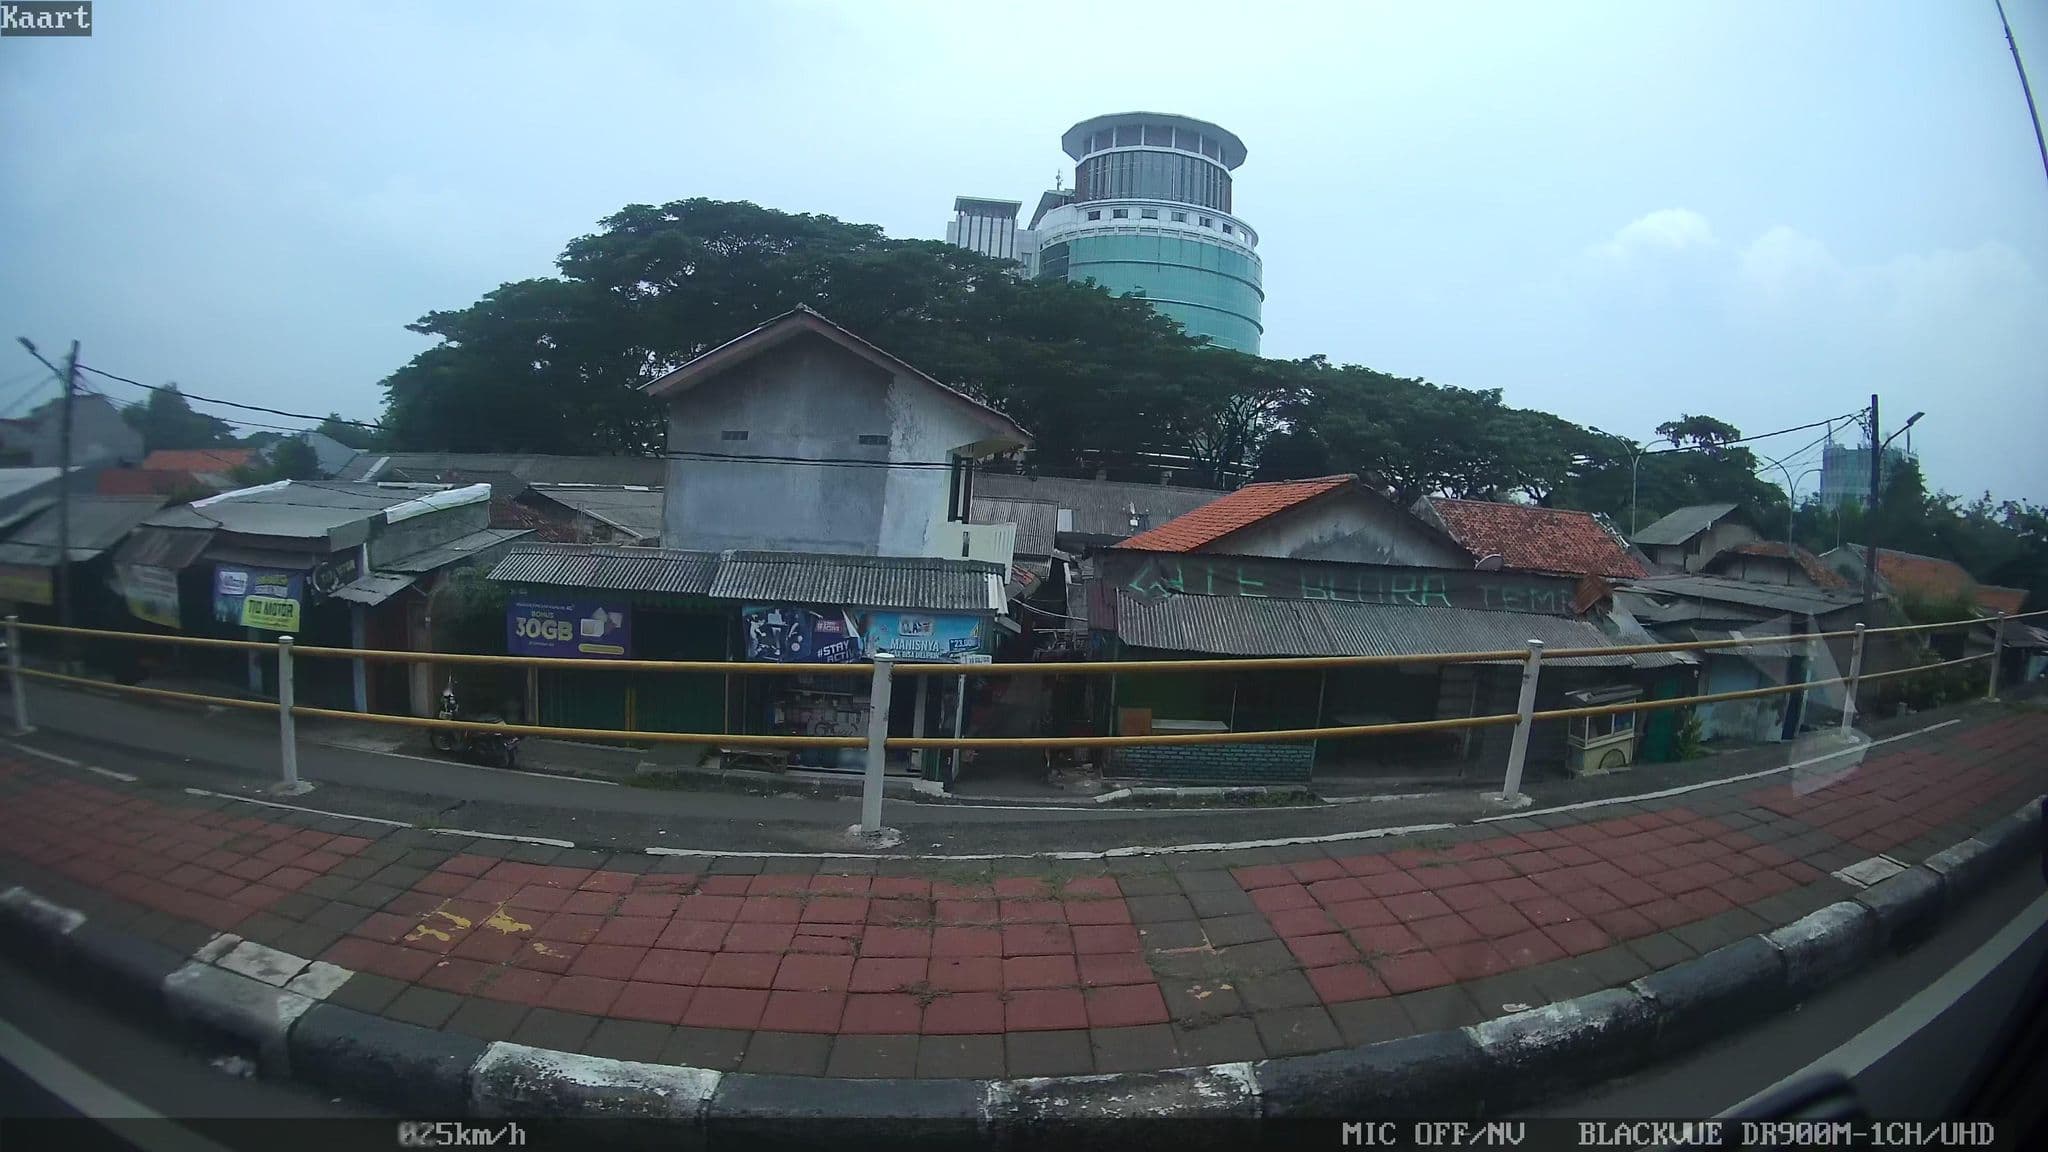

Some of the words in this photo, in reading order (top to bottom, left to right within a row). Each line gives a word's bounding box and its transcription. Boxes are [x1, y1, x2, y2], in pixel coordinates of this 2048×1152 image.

[263, 601, 294, 618] MOTOR
[515, 617, 573, 641] 30GB
[817, 640, 849, 659] #STAY
[890, 639, 939, 652] MANISNYA
